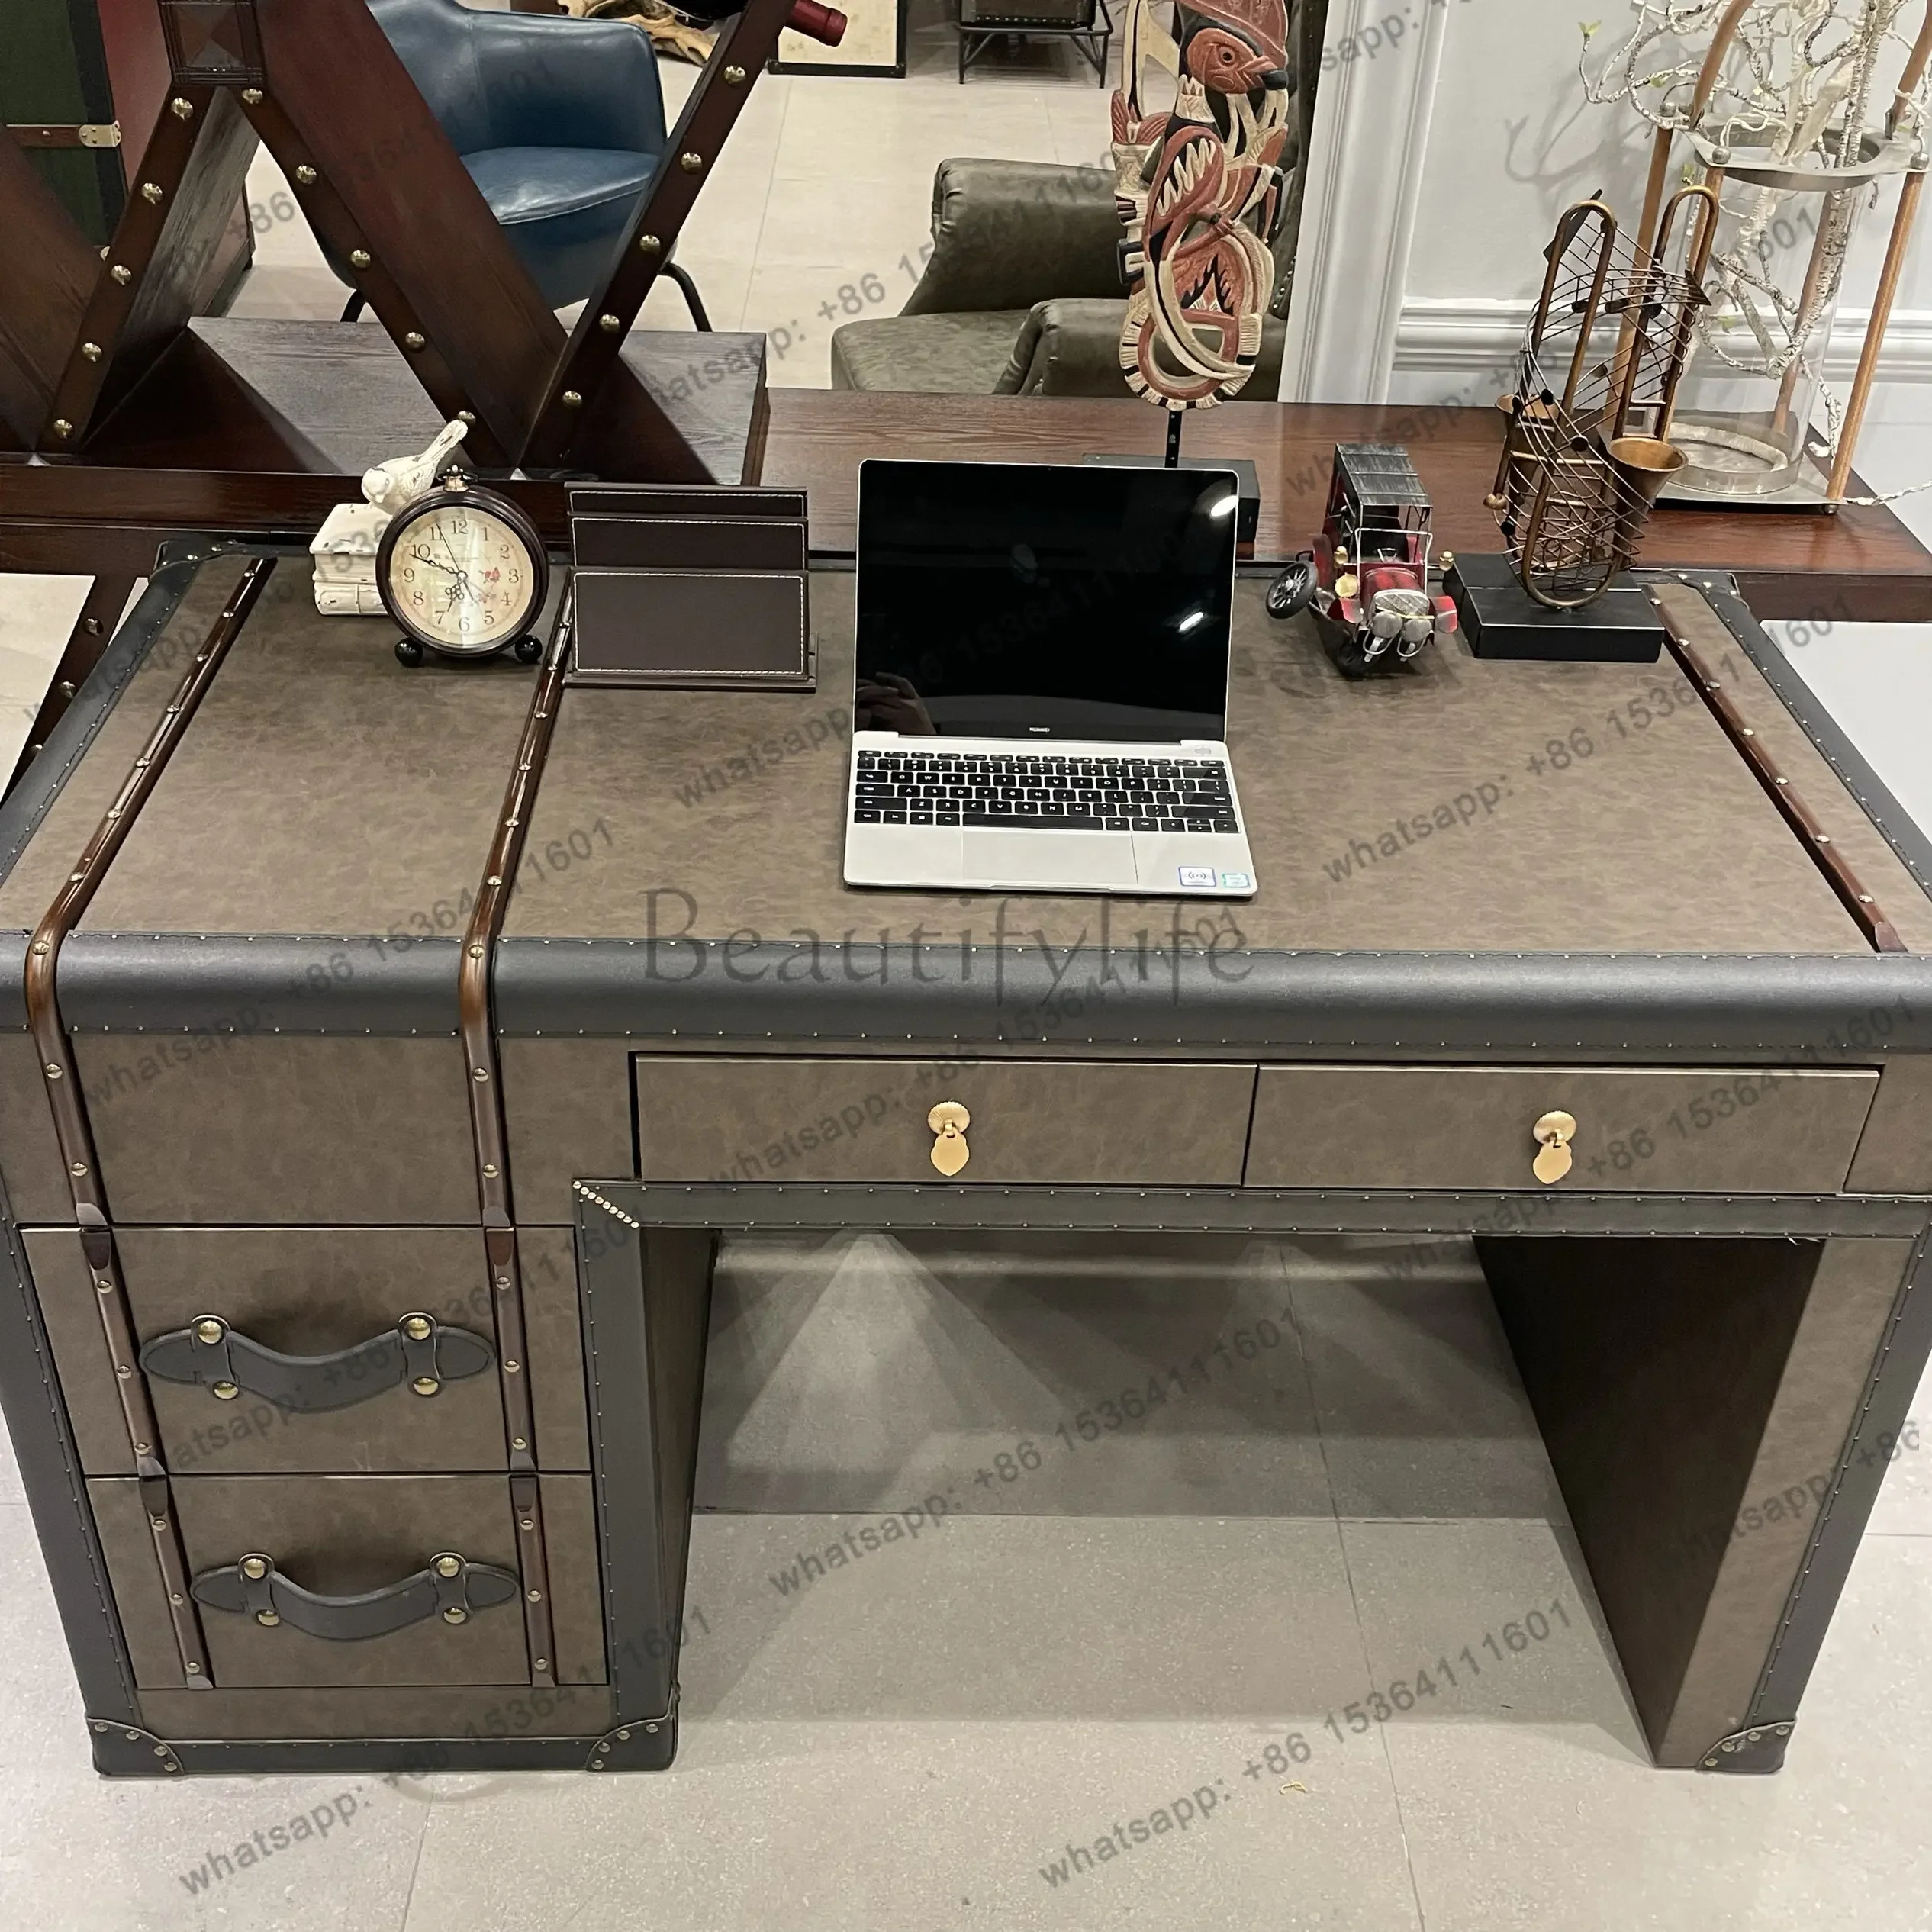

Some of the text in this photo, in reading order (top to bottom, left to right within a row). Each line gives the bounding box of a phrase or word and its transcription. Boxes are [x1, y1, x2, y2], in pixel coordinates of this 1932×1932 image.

[430, 526, 443, 540] 11
[452, 520, 468, 535] 12
[482, 527, 489, 541] 1
[410, 544, 430, 558] 10
[500, 545, 510, 559] 2
[404, 568, 415, 583] 9
[509, 569, 519, 584] 3
[413, 591, 424, 605] 8
[501, 592, 512, 606] 4
[435, 610, 445, 625] 7
[459, 617, 470, 632] 6
[484, 610, 494, 625] 5
